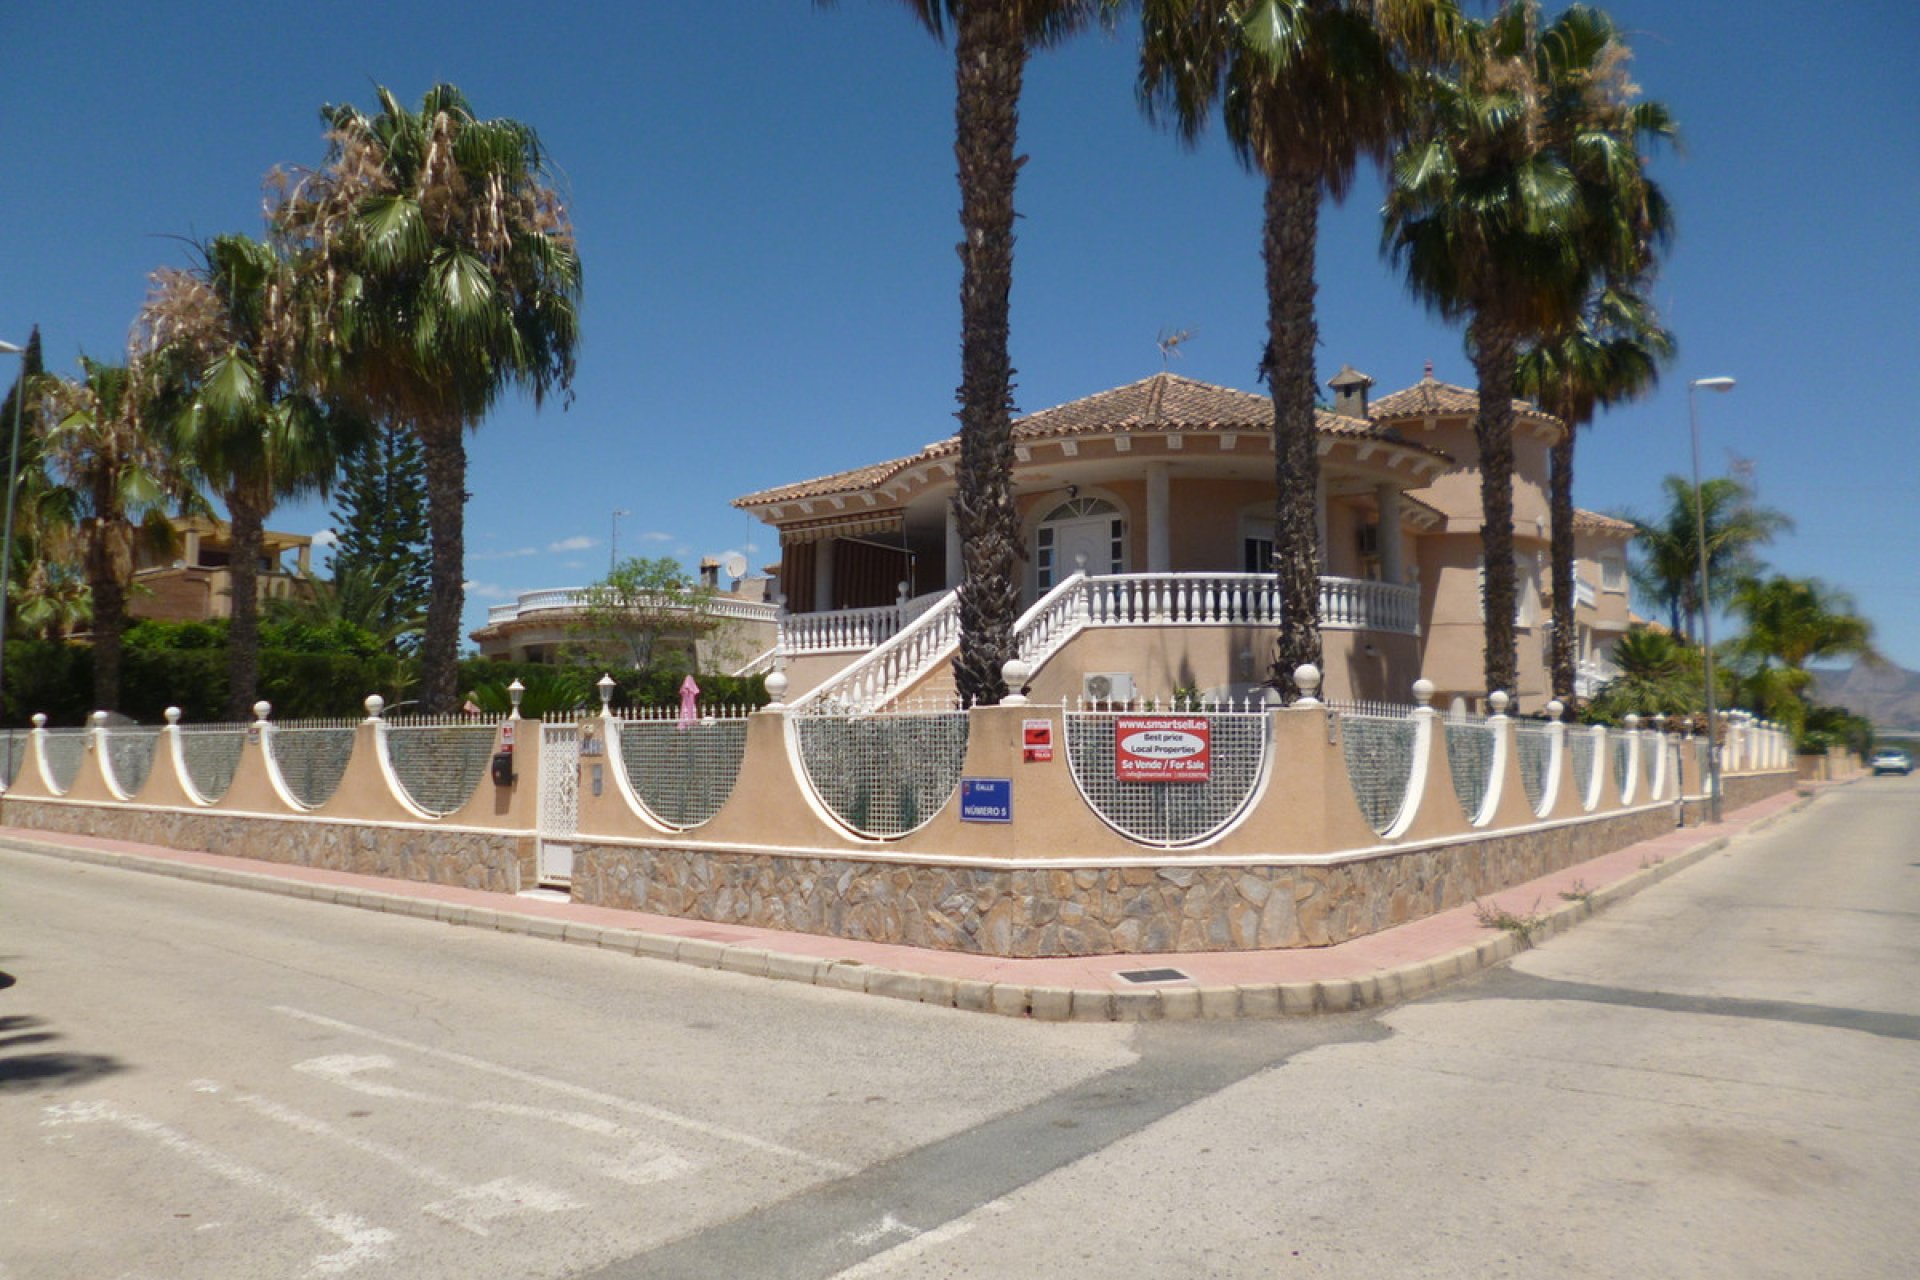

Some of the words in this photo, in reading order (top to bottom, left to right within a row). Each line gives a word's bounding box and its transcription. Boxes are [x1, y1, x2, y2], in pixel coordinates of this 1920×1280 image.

[1118, 720, 1207, 730] www.smartsell.es
[1143, 733, 1162, 741] Best
[1163, 734, 1183, 742] price
[1131, 745, 1152, 753] Local
[1154, 745, 1196, 754] Properties
[1122, 760, 1133, 769] Se
[1135, 760, 1162, 769] Vende
[1170, 760, 1185, 769] For
[1186, 760, 1204, 769] Sale
[975, 783, 995, 791] CALLE
[964, 805, 999, 816] NÚMERO
